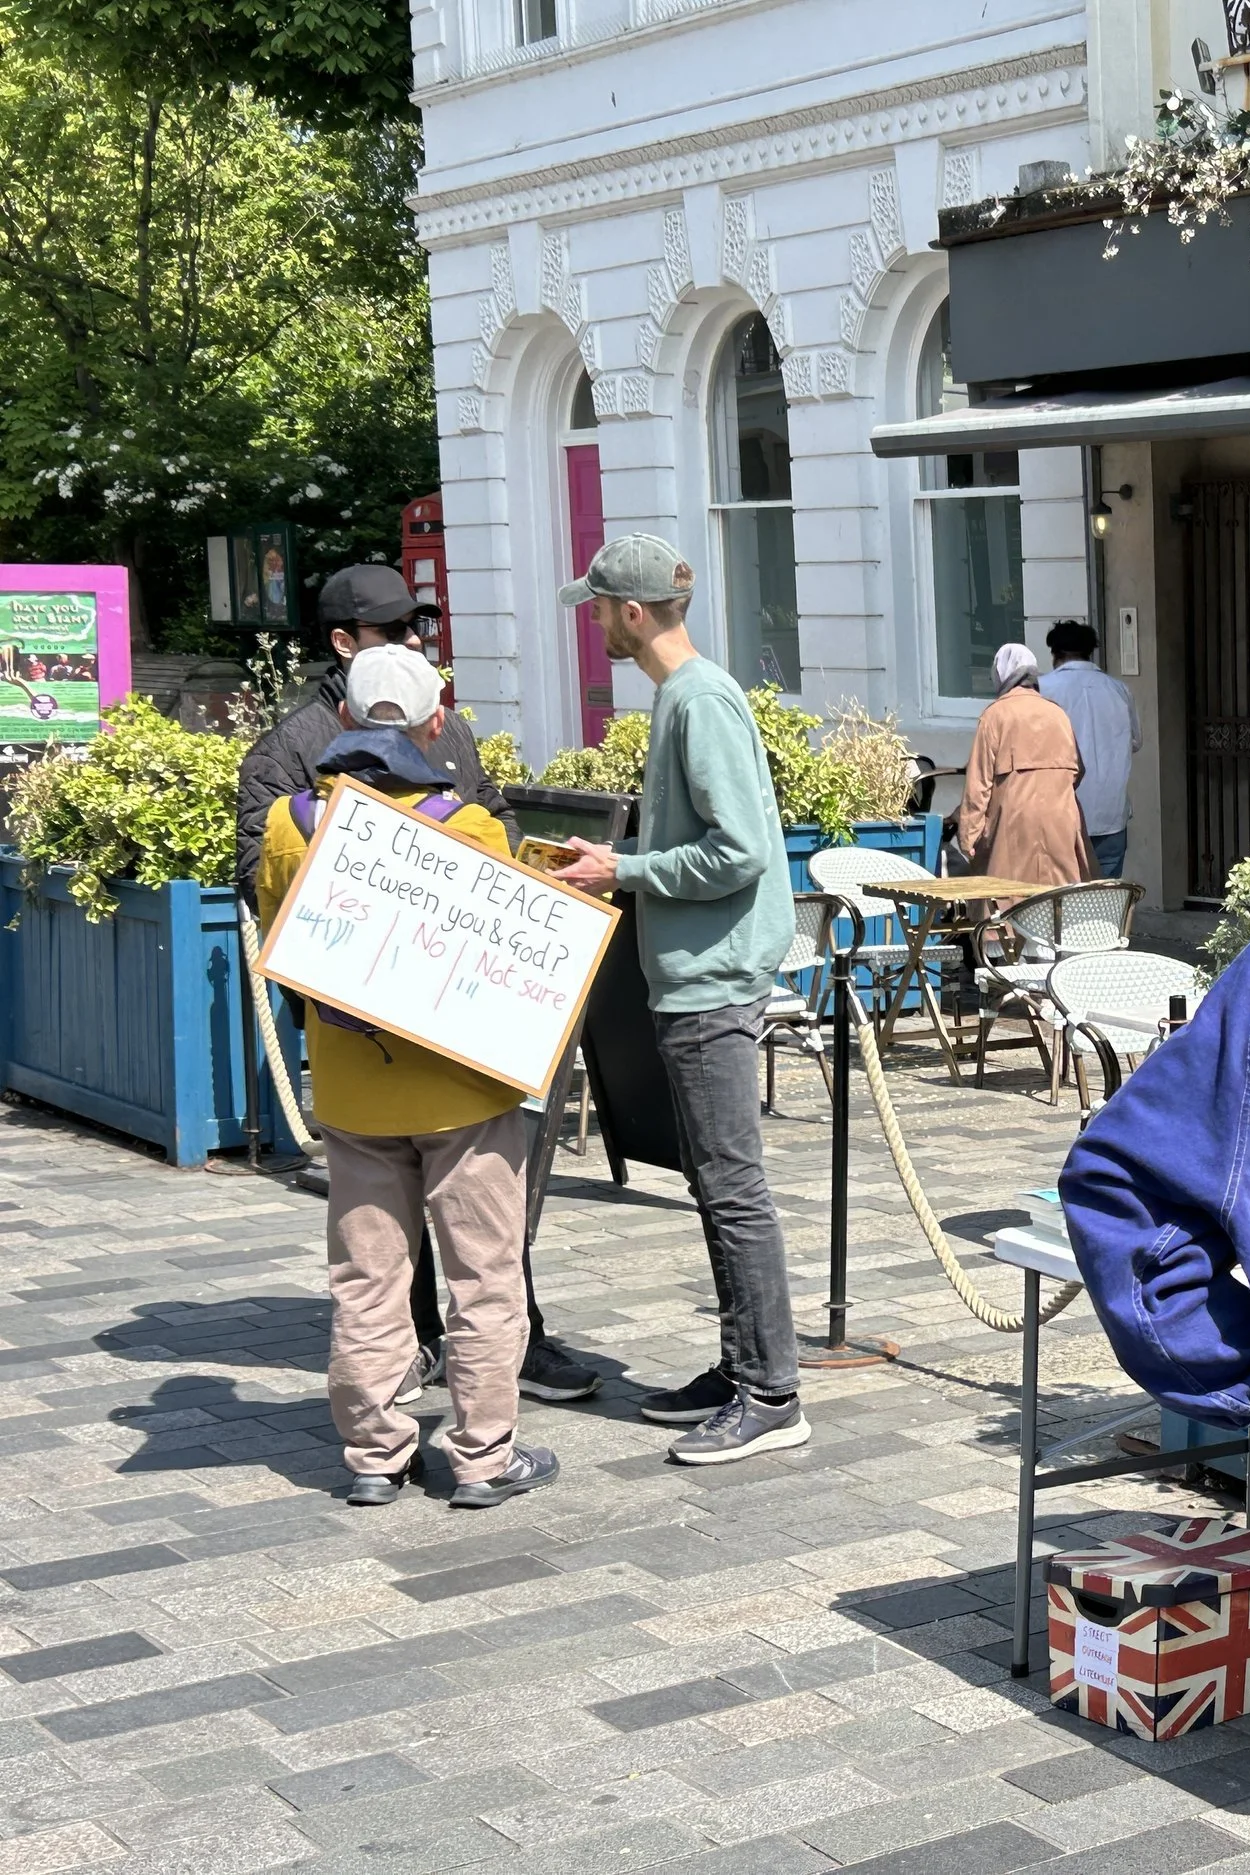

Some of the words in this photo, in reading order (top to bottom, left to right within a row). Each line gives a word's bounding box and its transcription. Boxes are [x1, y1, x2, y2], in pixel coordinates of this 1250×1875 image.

[333, 842, 440, 915] between
[338, 799, 376, 842] Is
[391, 822, 459, 881] there
[470, 861, 569, 933] PEACE
[325, 880, 371, 922] Yes
[411, 921, 447, 958] No
[474, 949, 518, 989] Not
[517, 978, 568, 1011] sure
[1082, 1625, 1112, 1643] STREET
